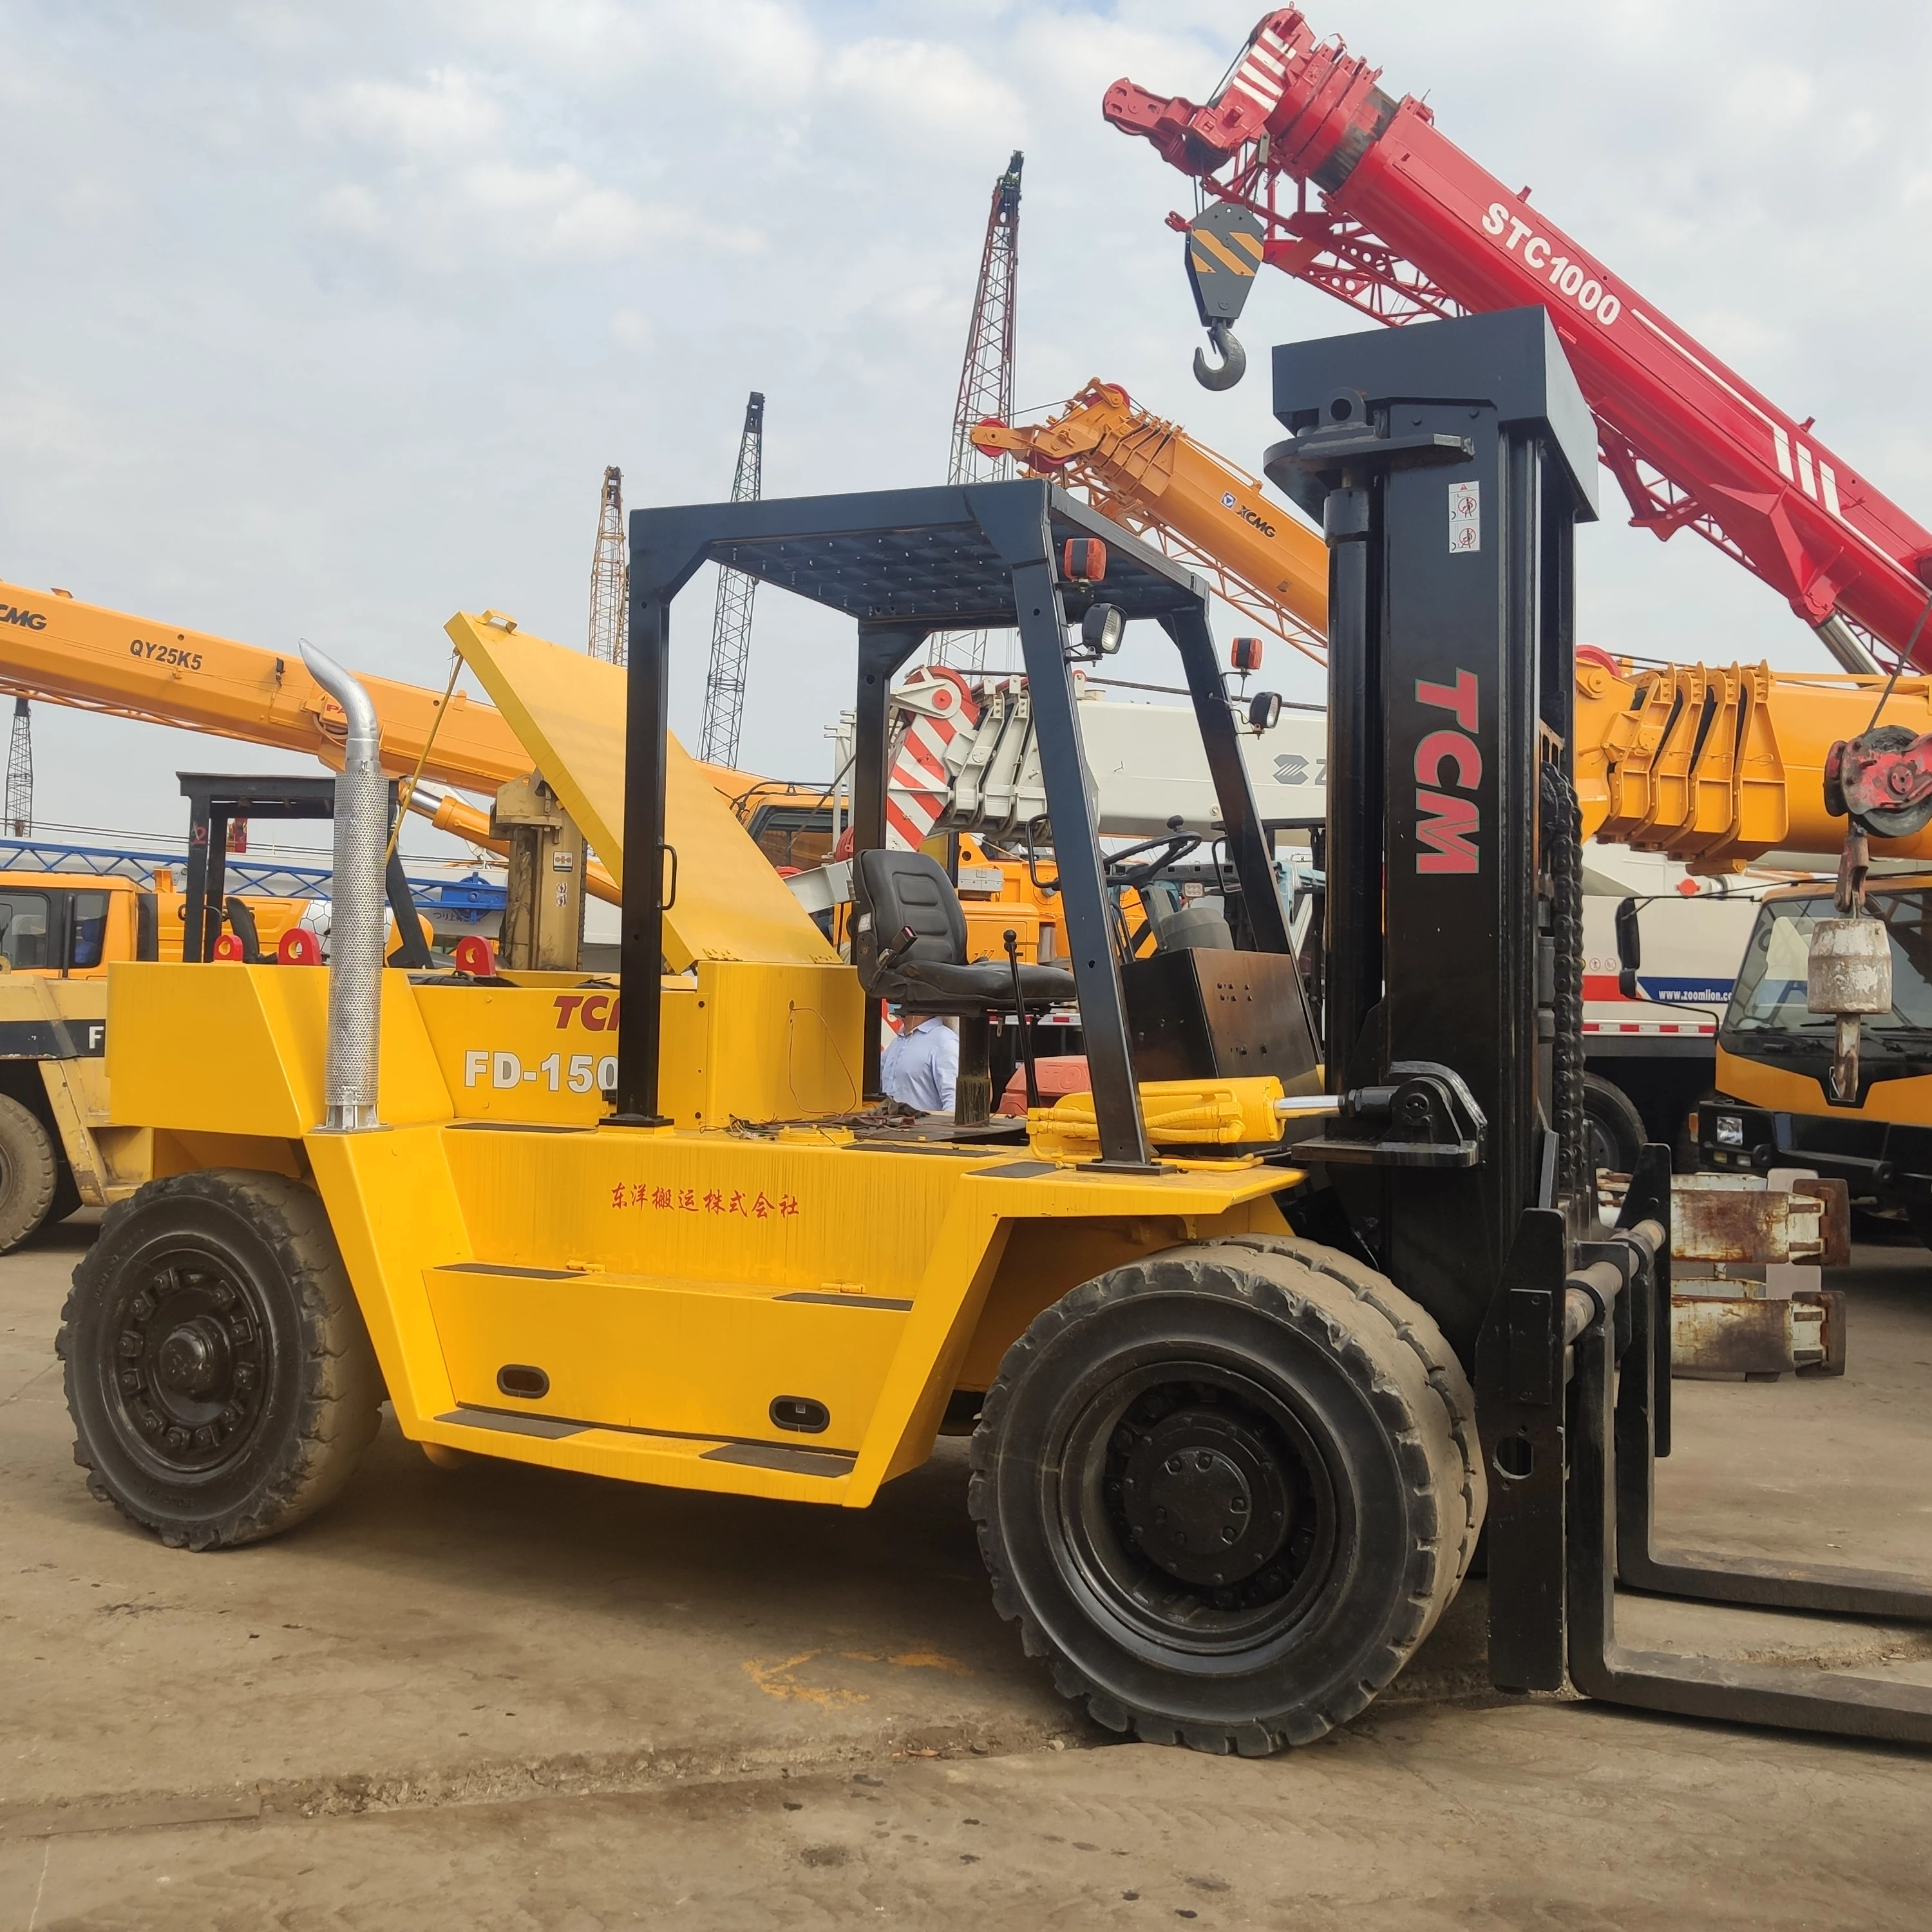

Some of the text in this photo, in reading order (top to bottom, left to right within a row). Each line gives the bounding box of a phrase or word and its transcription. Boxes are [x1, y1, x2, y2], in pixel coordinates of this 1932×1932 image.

[1482, 202, 1621, 325] STC1000
[1236, 504, 1276, 538] XCMG
[130, 639, 203, 670] QY25K5
[1414, 667, 1482, 873] TCM
[612, 1182, 800, 1218] 东洋搬运株式会社
